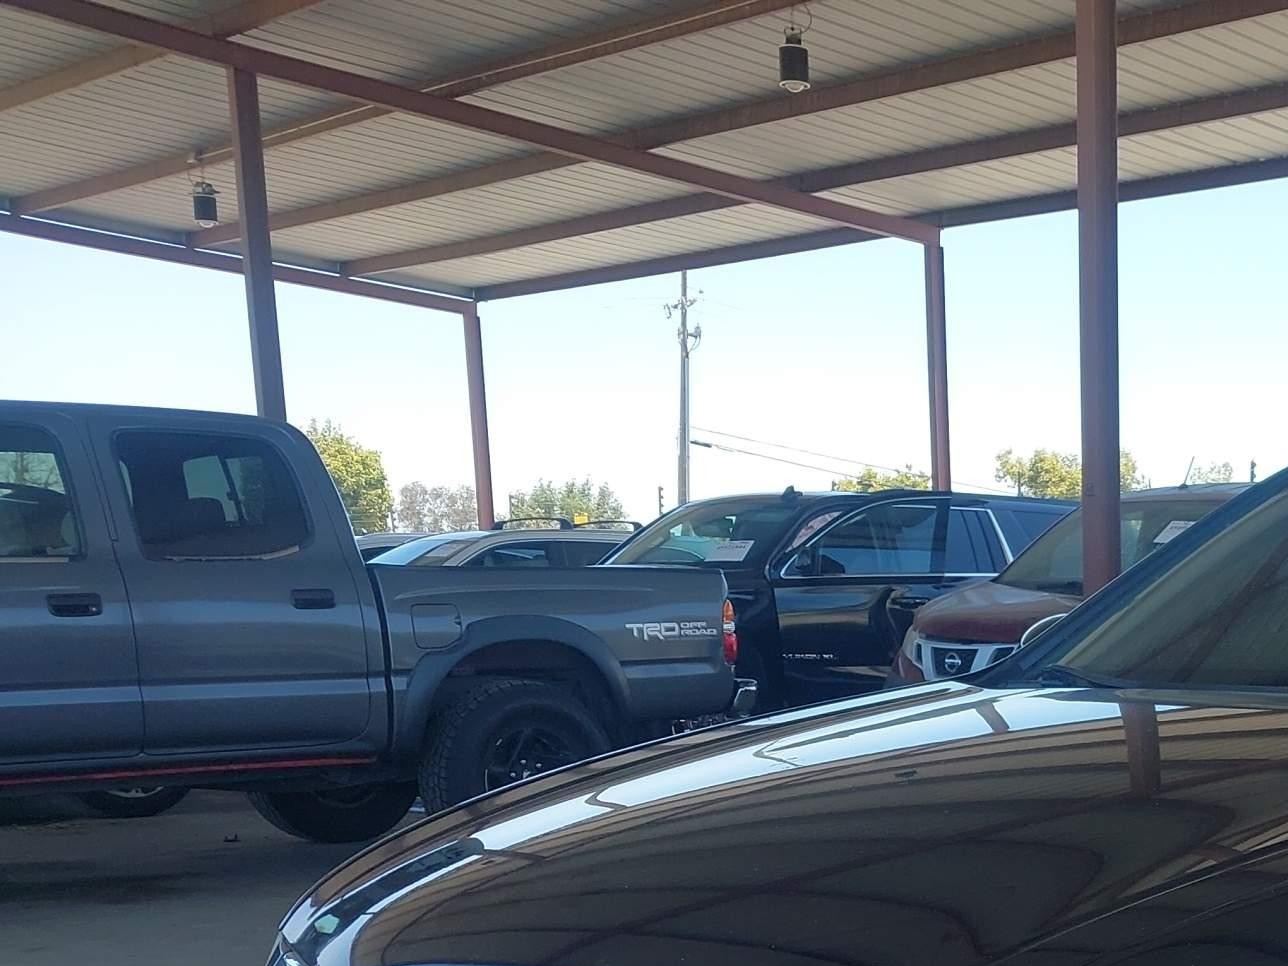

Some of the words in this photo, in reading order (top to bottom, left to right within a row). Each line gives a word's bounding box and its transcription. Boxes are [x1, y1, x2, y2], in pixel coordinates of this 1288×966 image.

[625, 622, 680, 641] TRD
[680, 621, 707, 629] OFF
[680, 629, 718, 637] ROAD
